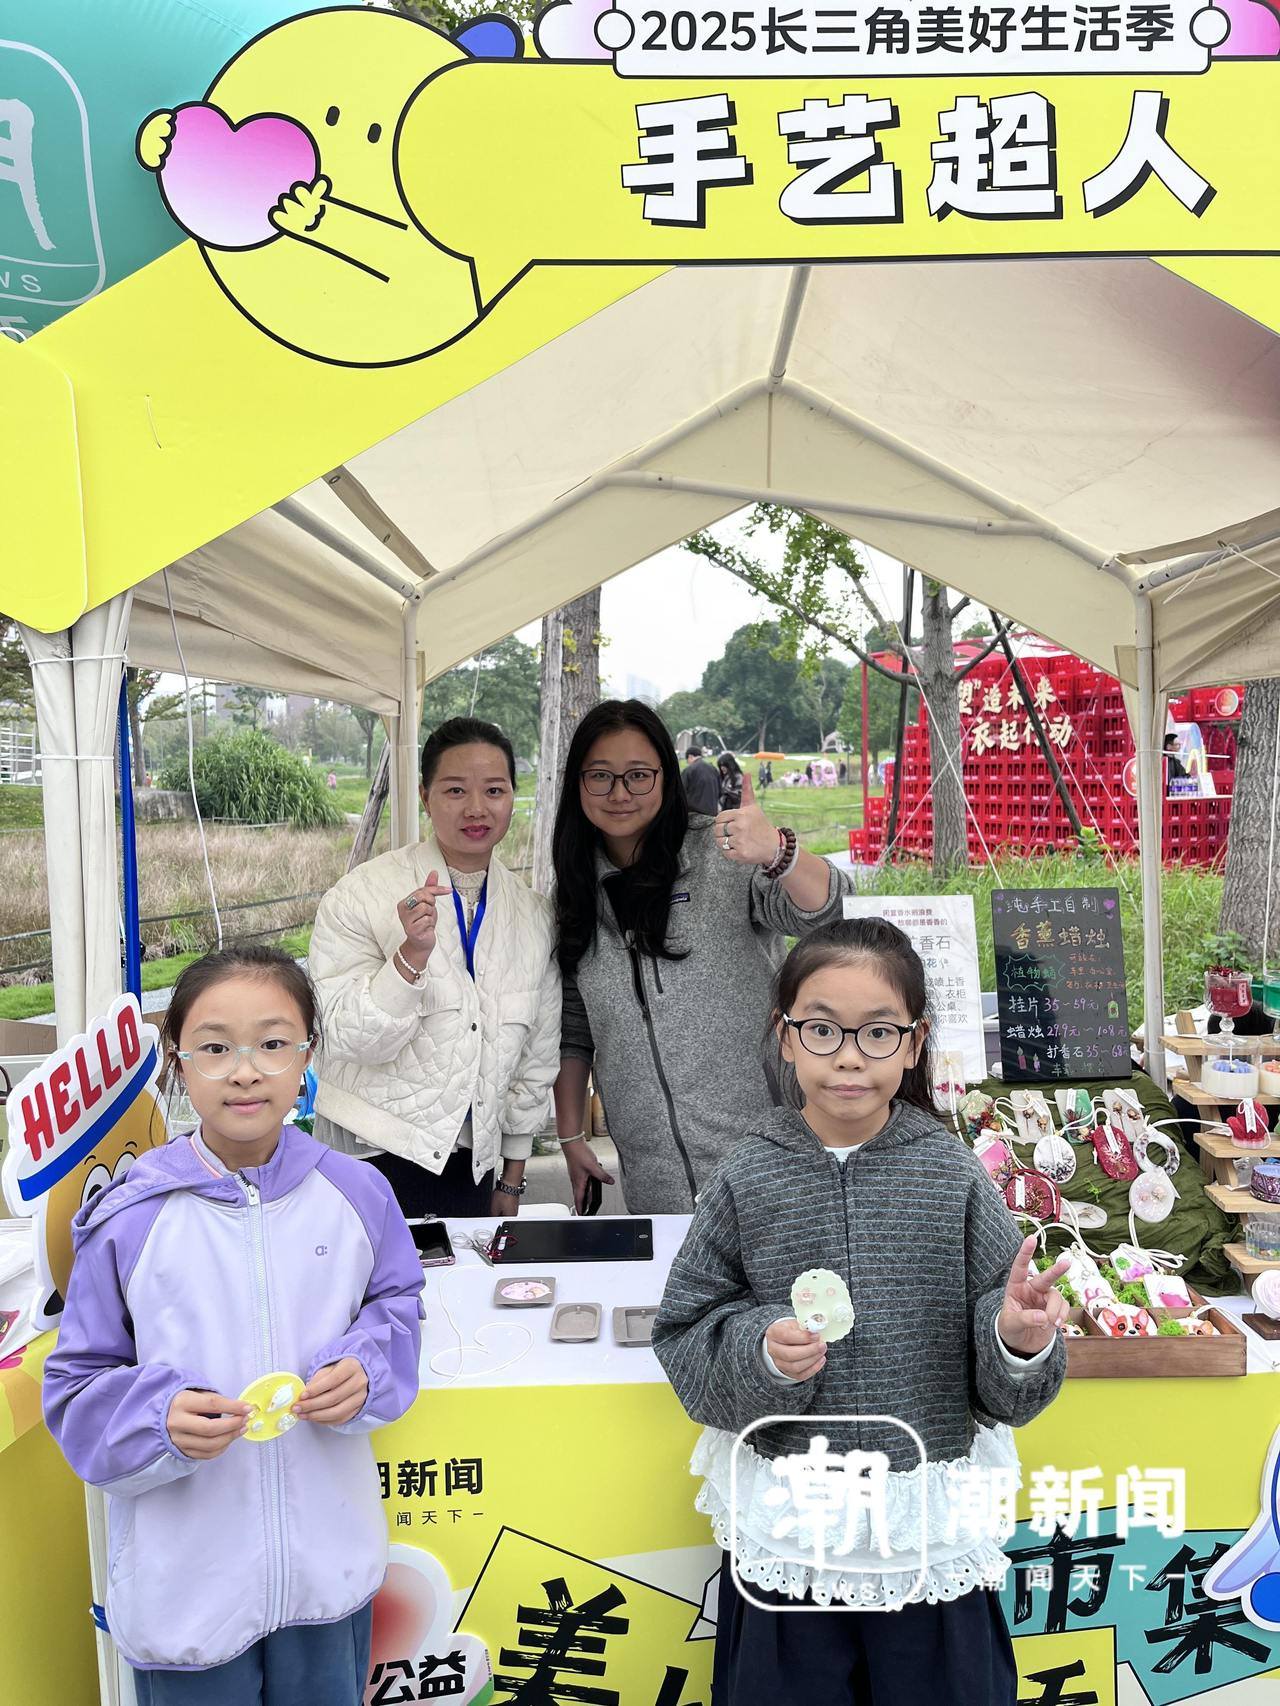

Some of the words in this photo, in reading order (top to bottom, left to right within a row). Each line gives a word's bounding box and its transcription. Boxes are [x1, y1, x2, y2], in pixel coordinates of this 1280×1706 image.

[641, 4, 1175, 55] 2025长三角美好生活季
[621, 90, 1217, 228] 手艺超人
[1006, 895, 1100, 914] 纯手工自制
[21, 1005, 141, 1162] HELLO
[371, 1650, 466, 1706] 公益
